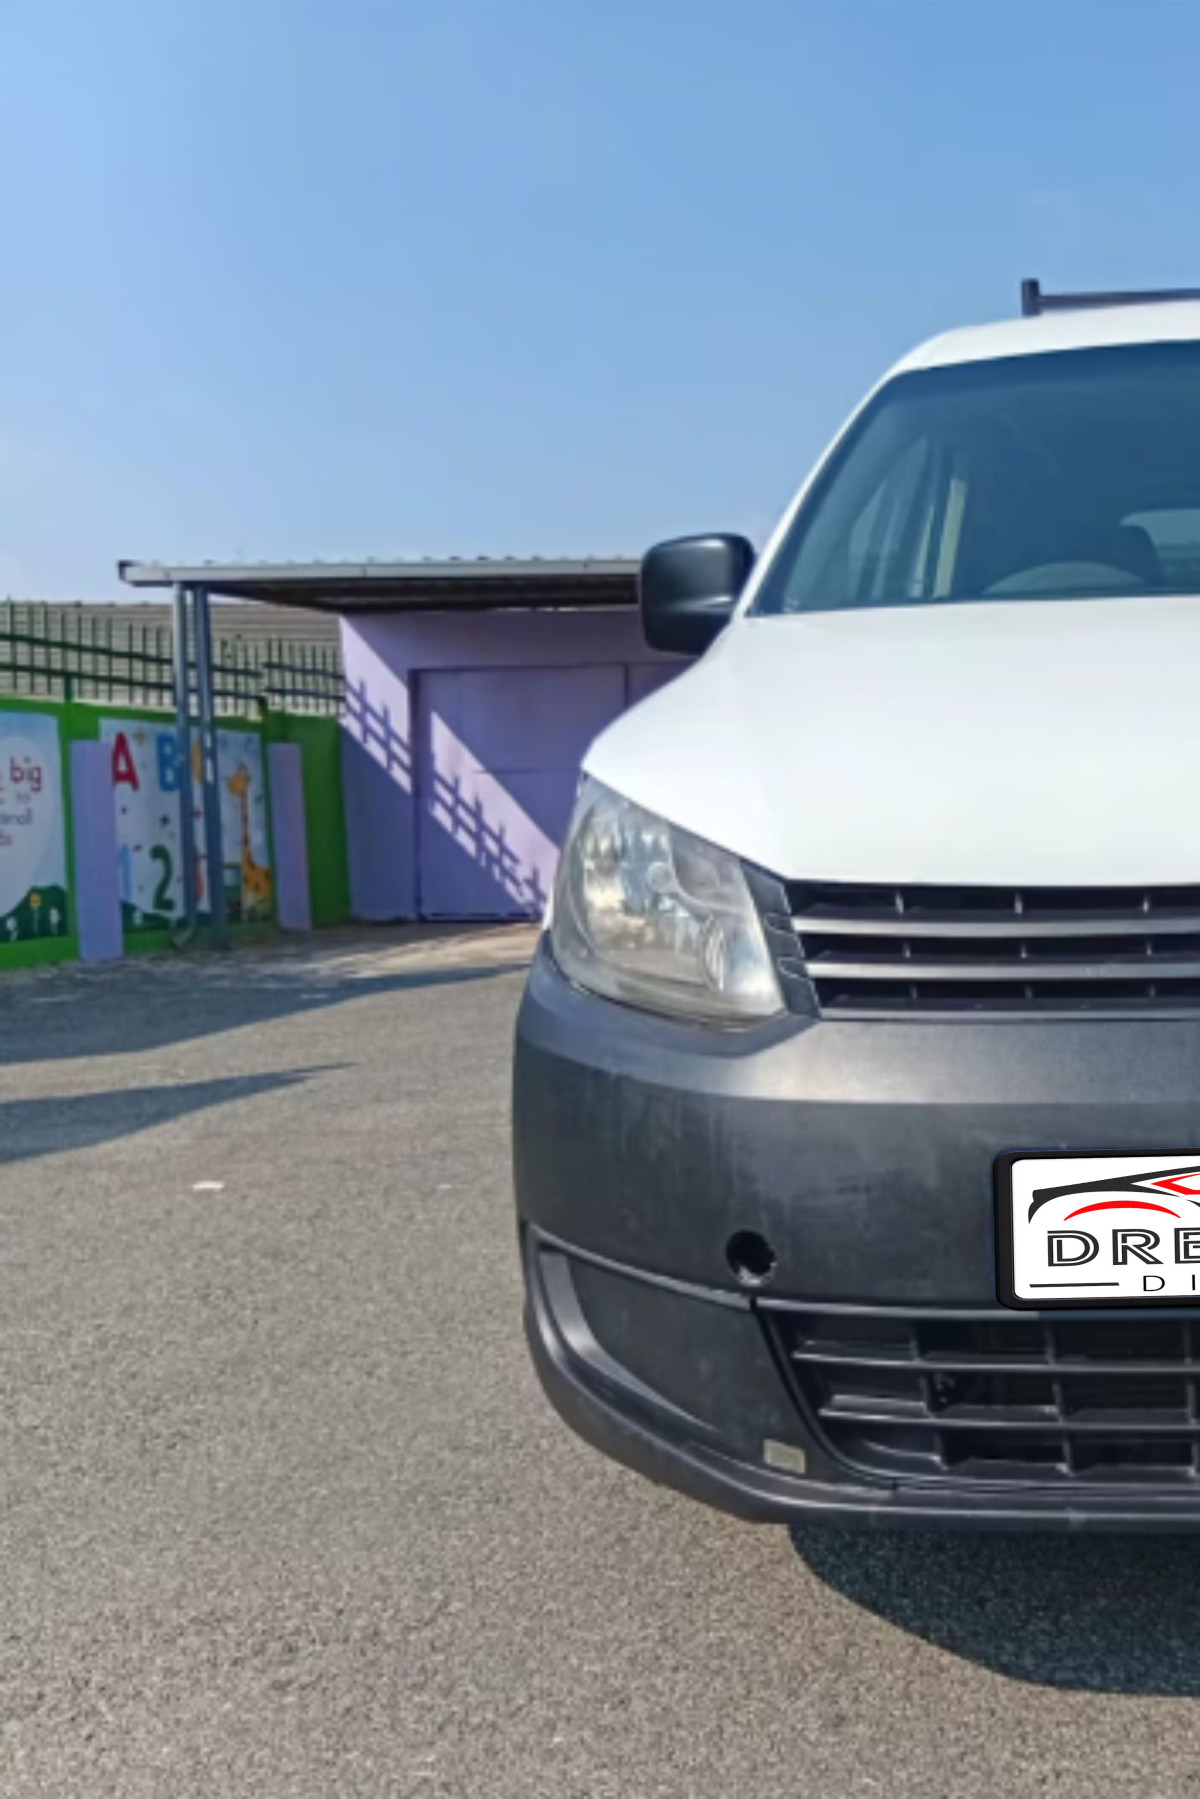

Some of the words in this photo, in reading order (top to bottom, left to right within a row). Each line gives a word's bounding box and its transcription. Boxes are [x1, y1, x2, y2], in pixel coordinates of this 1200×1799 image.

[10, 756, 42, 792] big
[112, 731, 140, 791] A
[149, 844, 175, 910] 2
